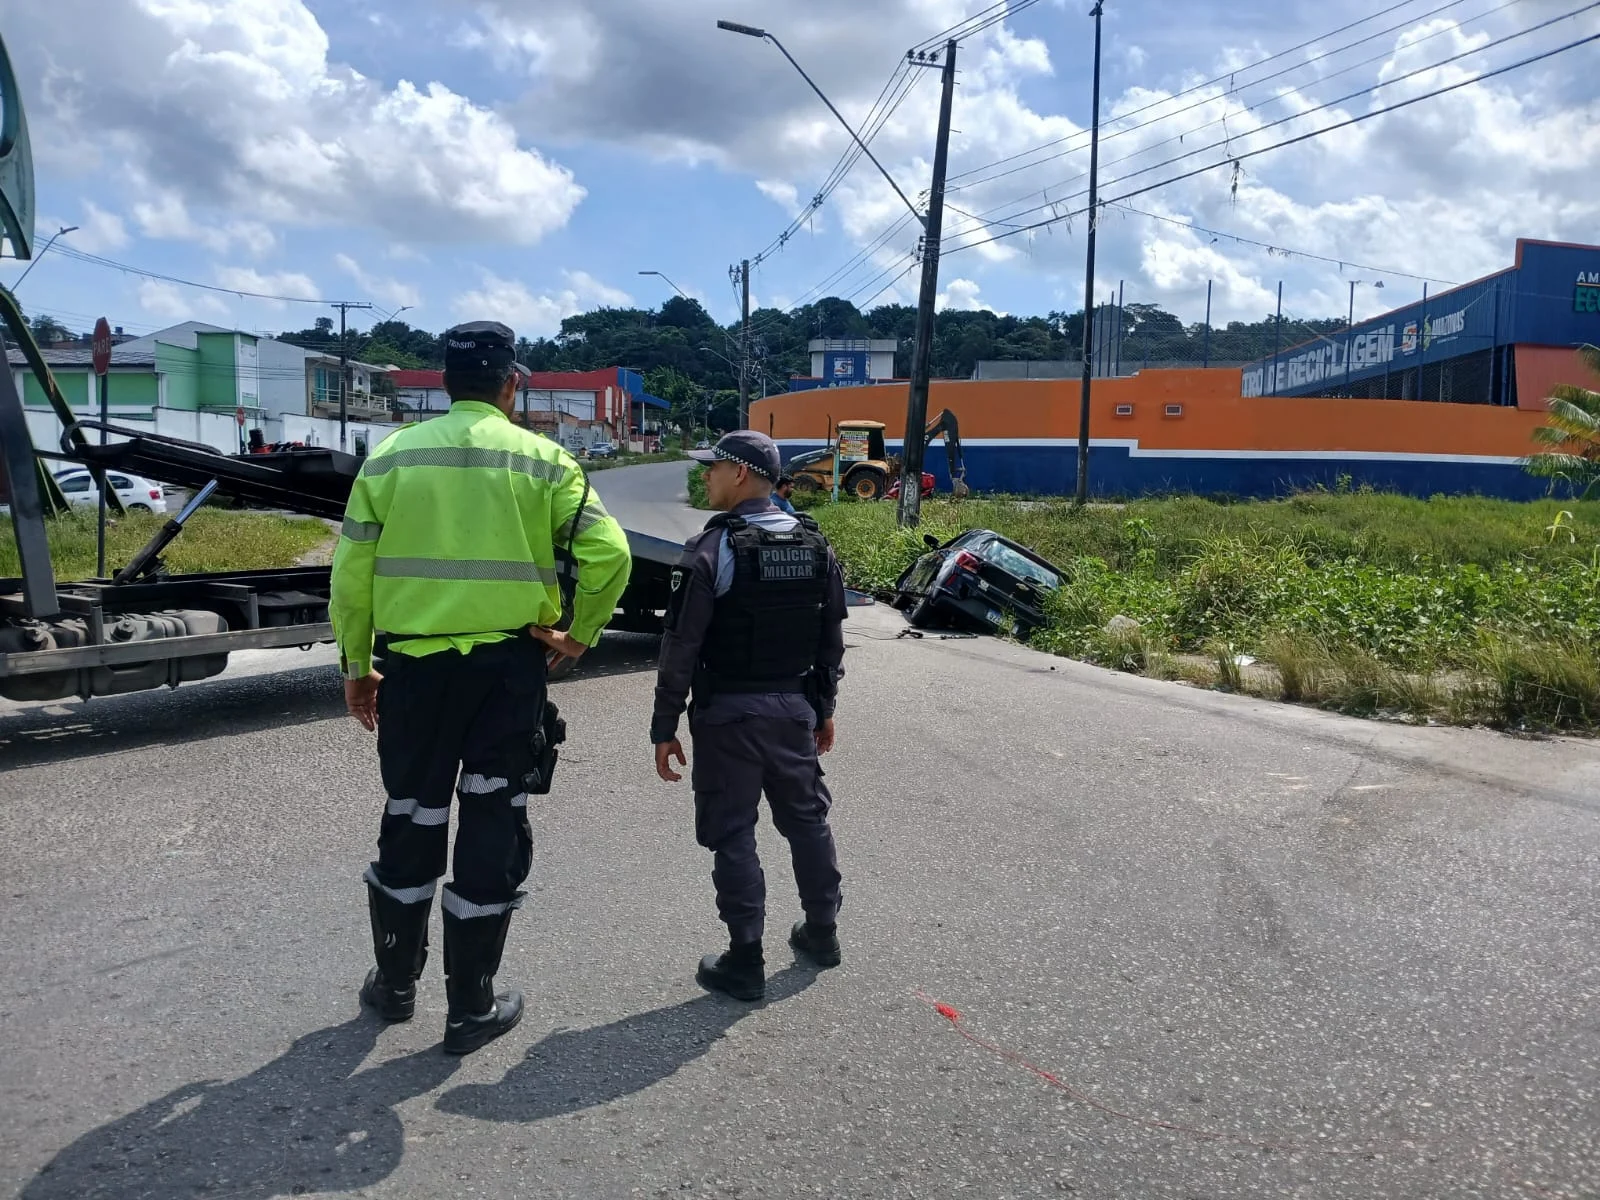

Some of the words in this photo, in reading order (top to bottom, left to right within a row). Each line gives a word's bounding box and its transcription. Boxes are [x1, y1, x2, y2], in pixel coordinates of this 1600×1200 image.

[1575, 287, 1600, 312] EC
[762, 548, 812, 561] POLÍCIA
[763, 565, 813, 578] MILITAR
